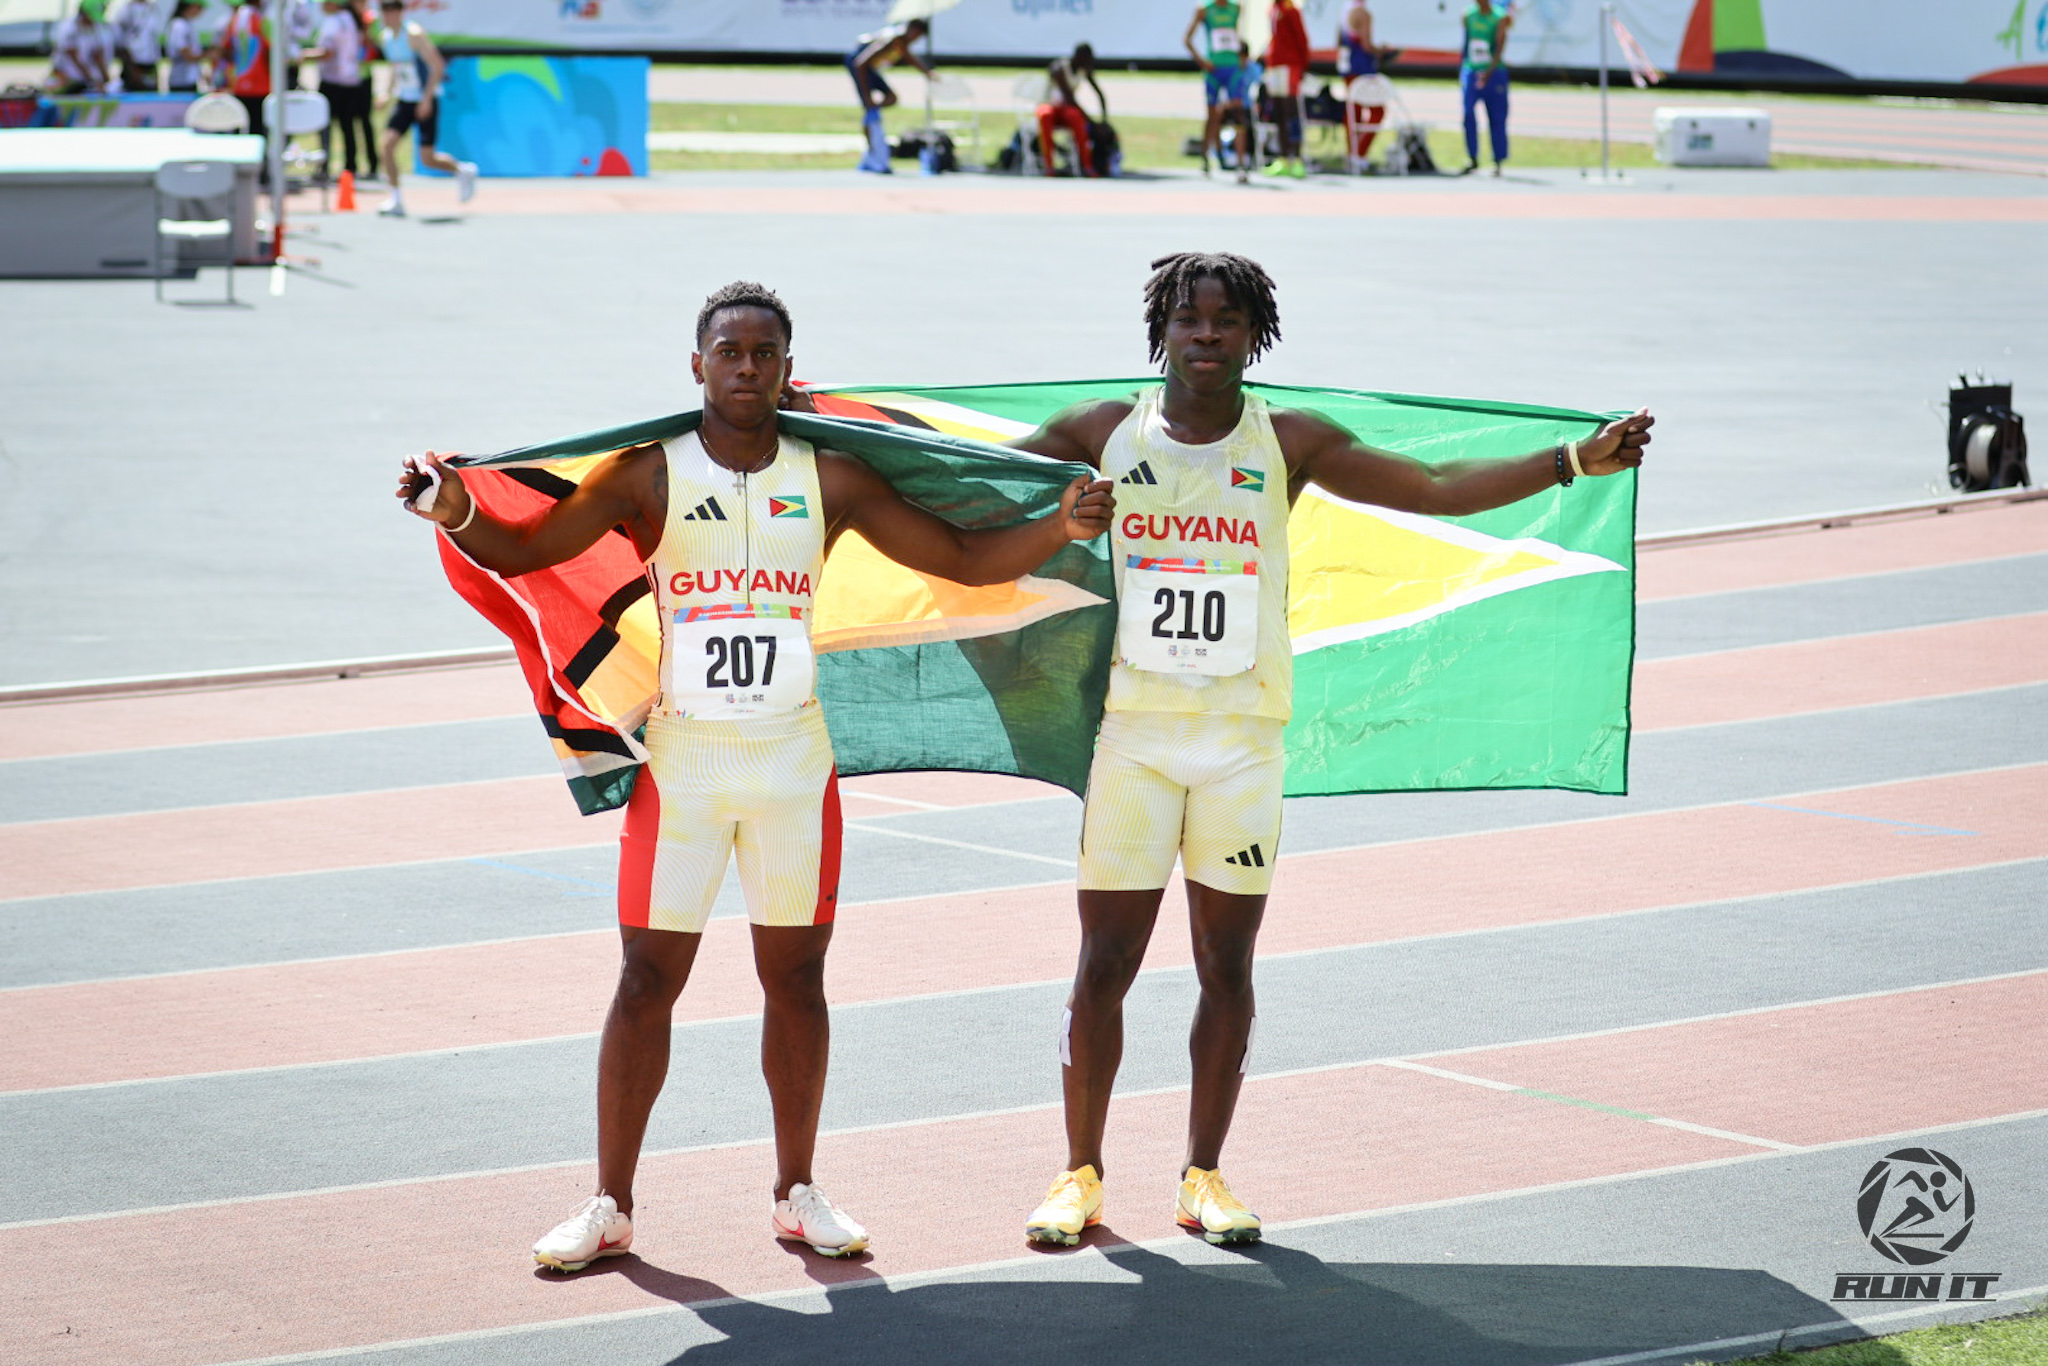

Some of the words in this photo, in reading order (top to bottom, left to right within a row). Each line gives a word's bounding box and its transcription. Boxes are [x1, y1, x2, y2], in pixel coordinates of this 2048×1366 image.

[1122, 512, 1259, 547] GUYANA
[669, 568, 812, 597] GUYANA
[1151, 587, 1226, 642] 210
[705, 634, 777, 689] 207
